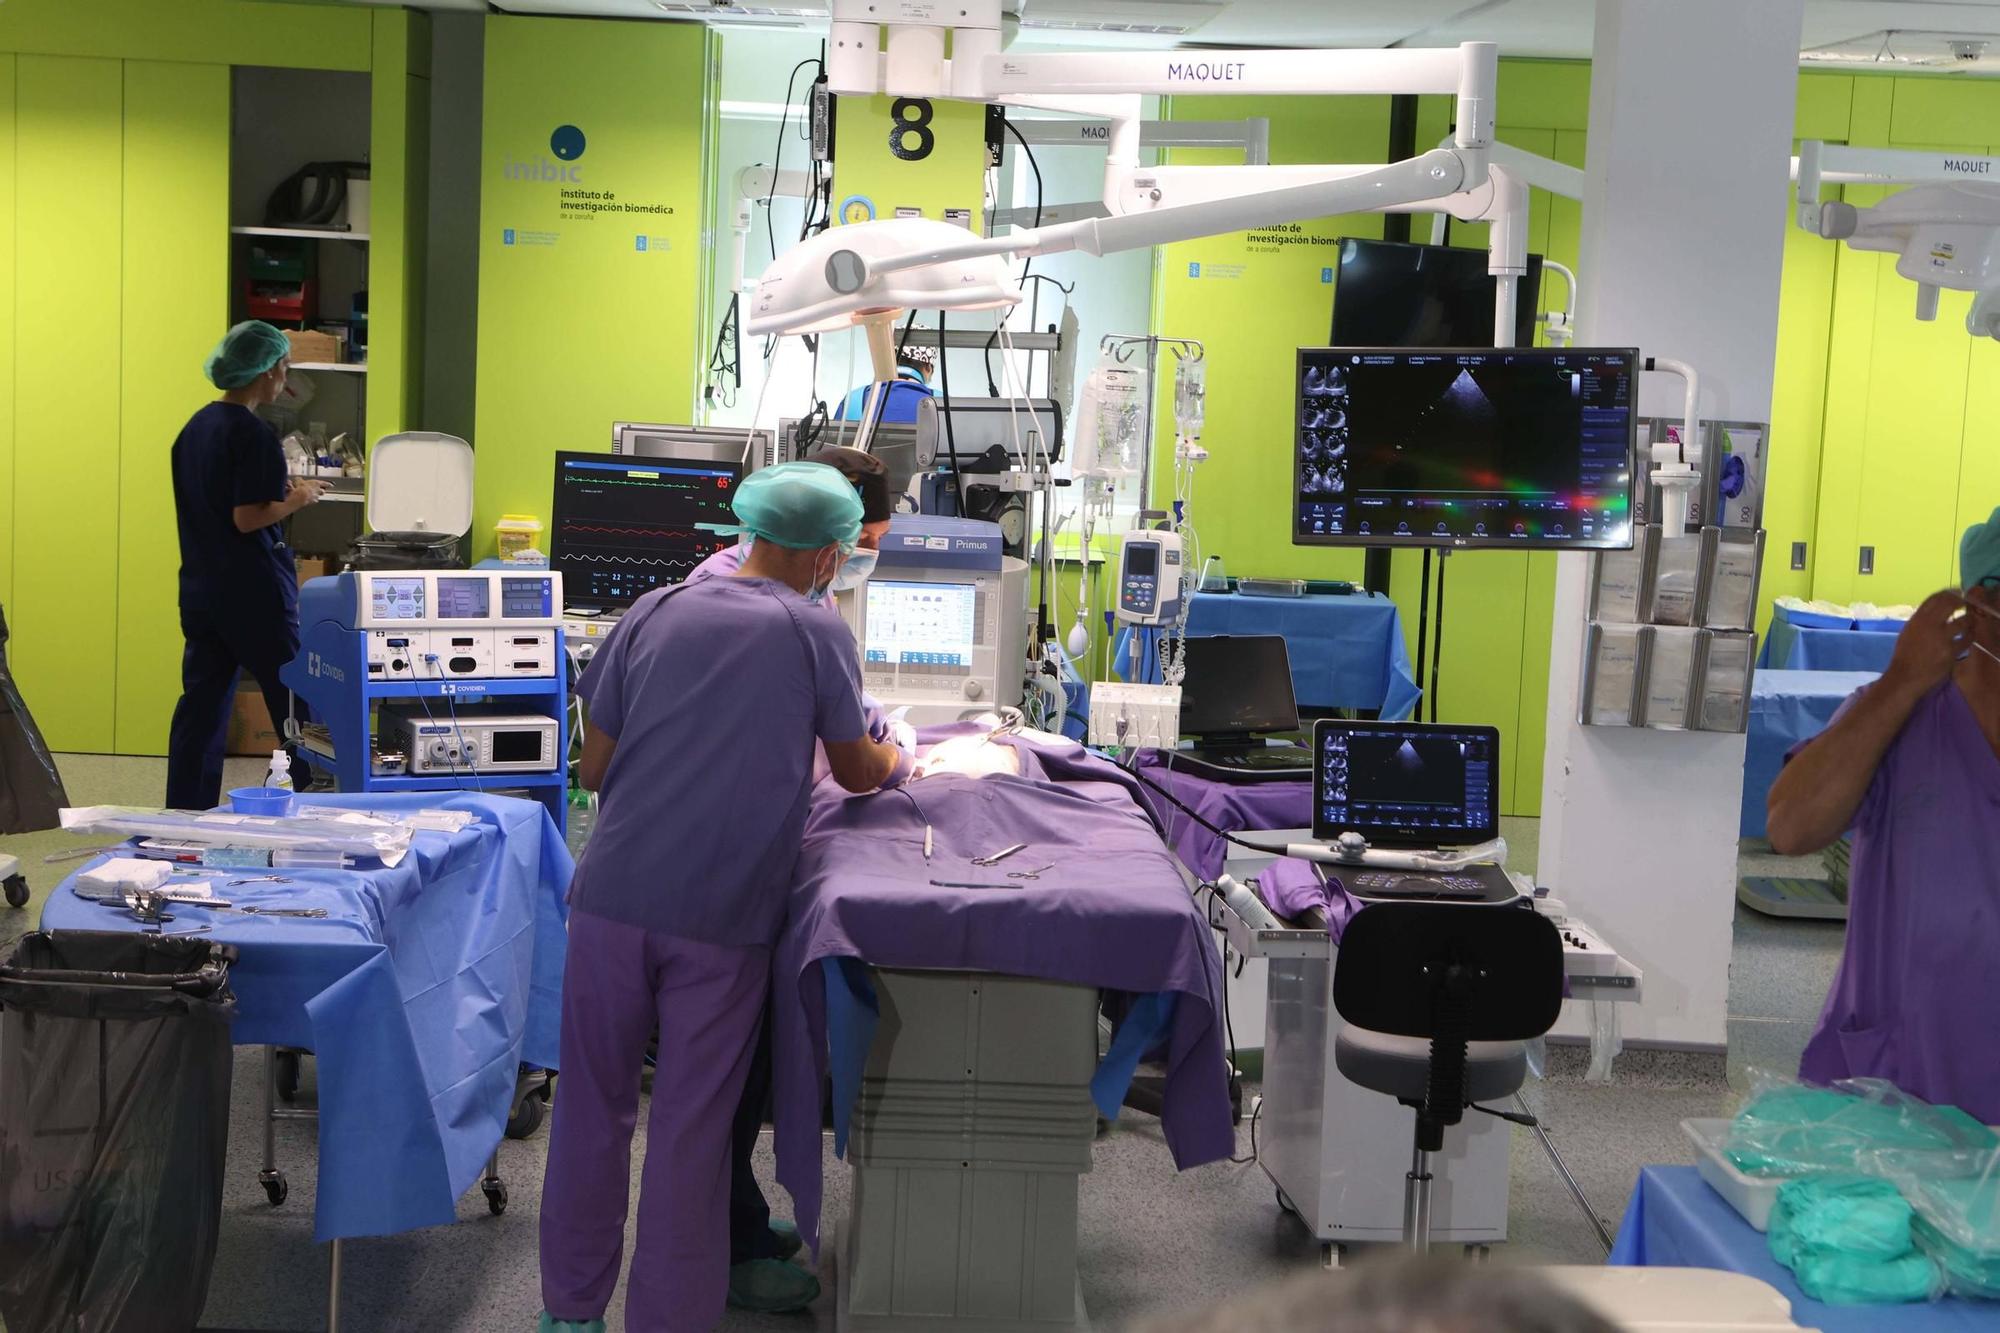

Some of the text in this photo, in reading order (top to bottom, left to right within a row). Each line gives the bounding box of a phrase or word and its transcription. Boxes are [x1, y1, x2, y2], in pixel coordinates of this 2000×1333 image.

[1168, 63, 1245, 82] MAQUET
[889, 97, 934, 161] 8
[503, 153, 583, 183] inibic
[1944, 159, 1992, 174] MAQUET
[560, 188, 615, 200] instituto de
[560, 200, 674, 215] investigación biomédica
[1289, 223, 1302, 232] de
[1247, 233, 1309, 246] investigación
[955, 539, 988, 550] Primus
